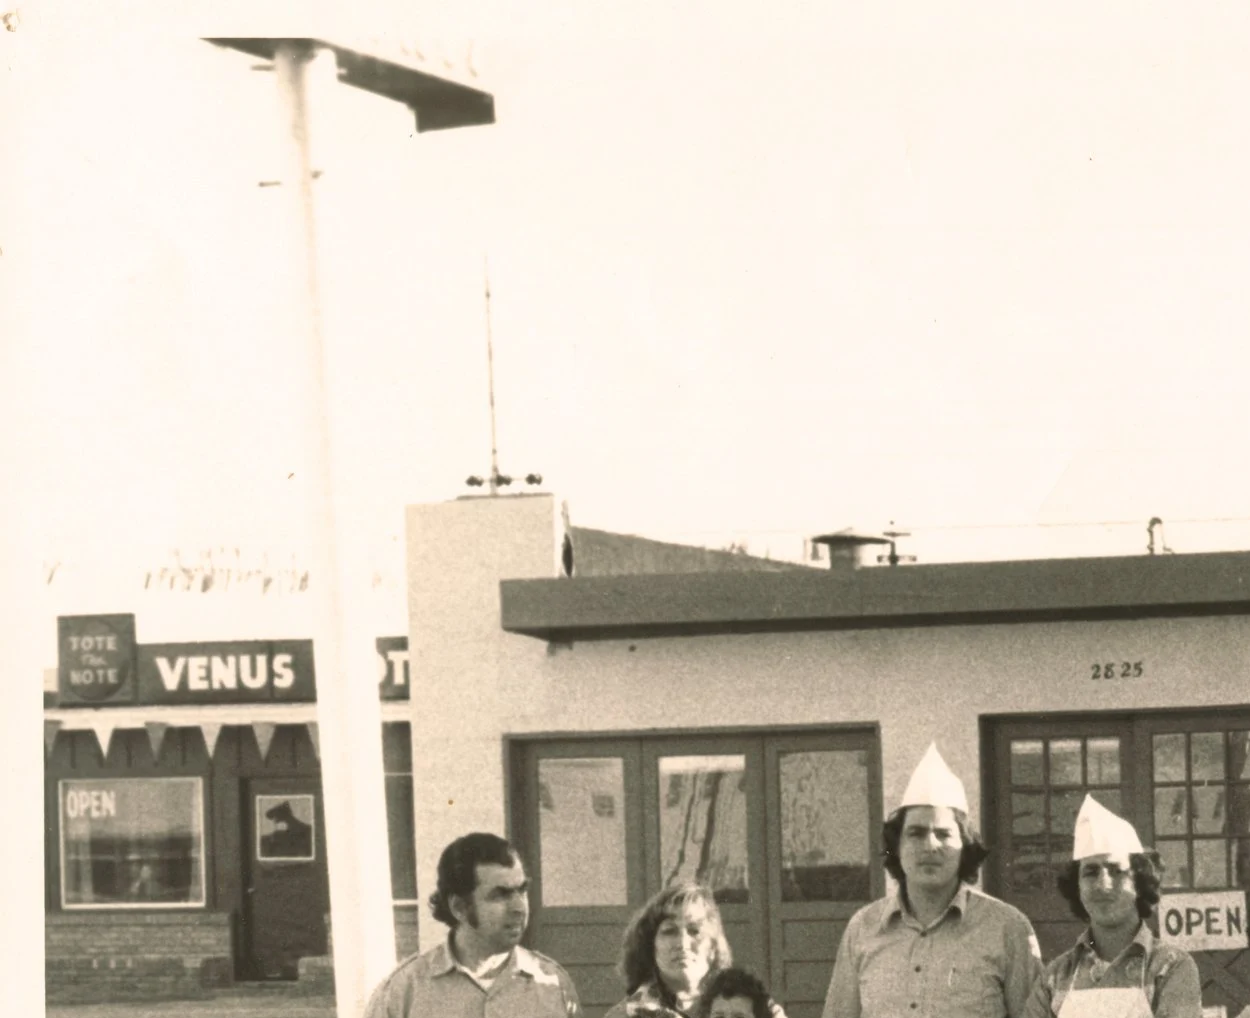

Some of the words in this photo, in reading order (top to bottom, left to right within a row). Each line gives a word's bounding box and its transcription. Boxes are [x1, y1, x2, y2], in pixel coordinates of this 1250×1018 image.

[68, 635, 118, 651] TOTE
[70, 668, 118, 684] NOTE
[155, 653, 295, 691] VENUS
[1091, 661, 1144, 680] 2825
[66, 790, 117, 818] OPEN
[1165, 906, 1242, 937] OPEN
